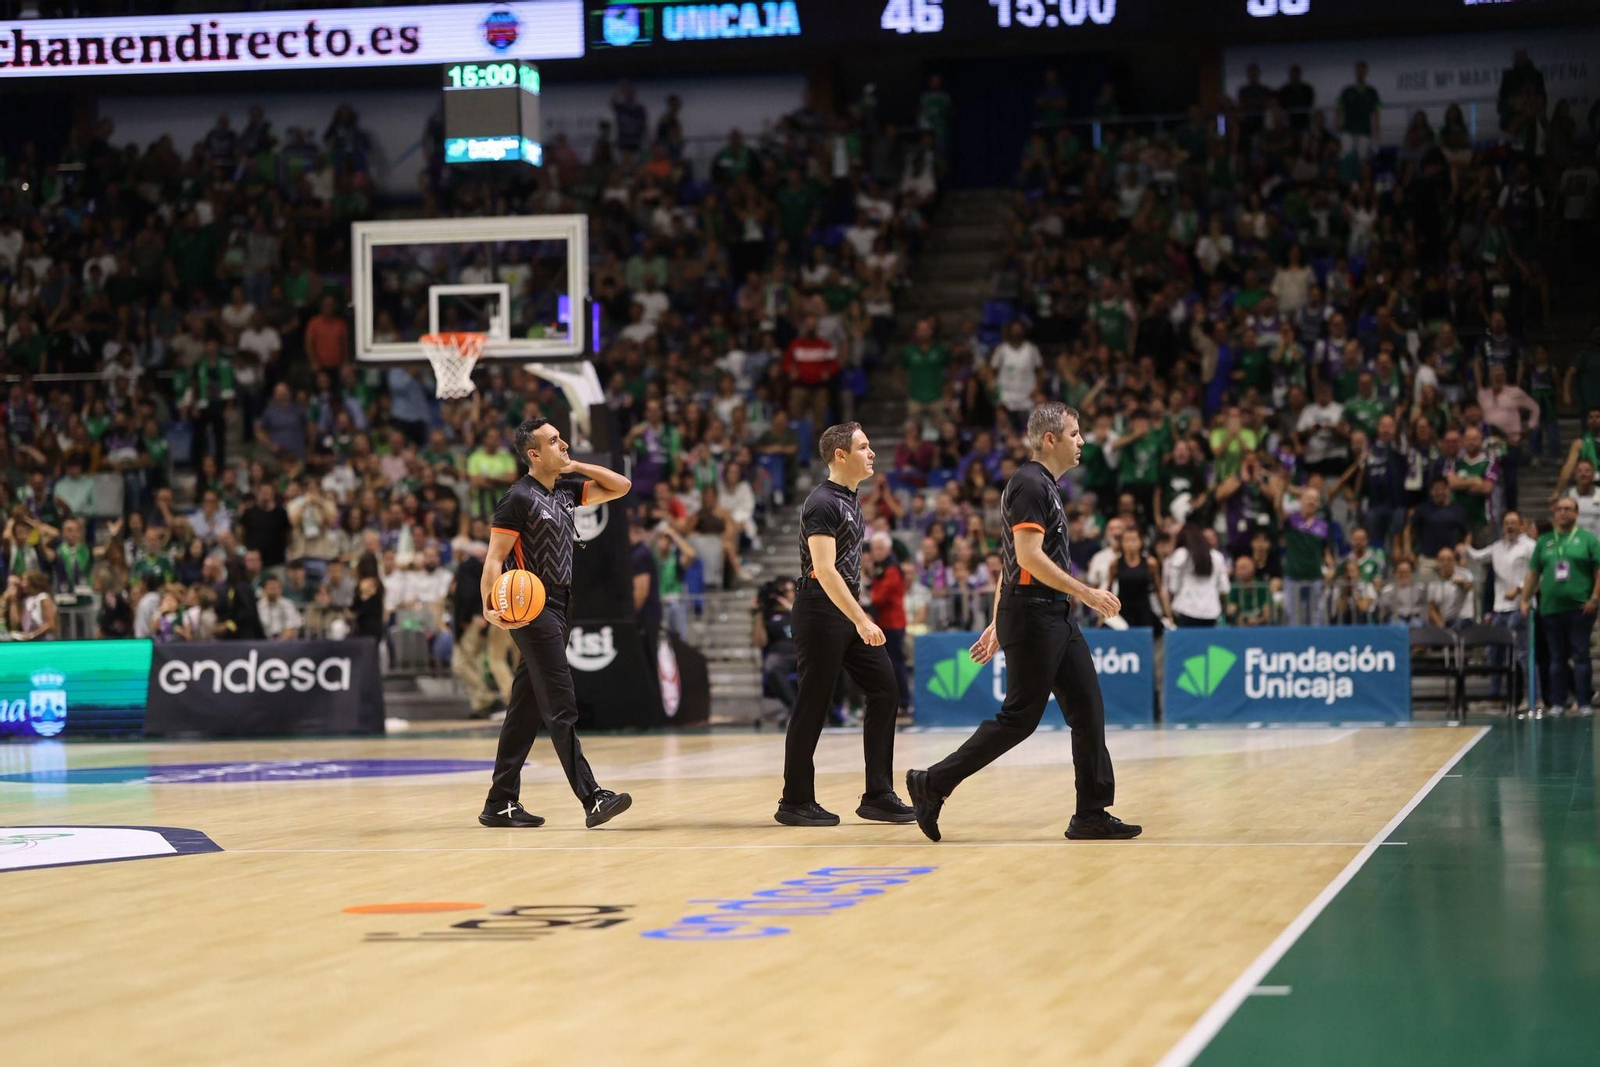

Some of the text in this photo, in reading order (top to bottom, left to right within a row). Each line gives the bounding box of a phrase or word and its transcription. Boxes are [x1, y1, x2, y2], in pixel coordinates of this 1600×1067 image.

[662, 1, 801, 39] UNICAJA
[881, 0, 944, 34] 46
[448, 63, 516, 88] 15:00
[158, 648, 352, 695] endesa
[1244, 645, 1396, 674] Fundación
[1244, 673, 1354, 705] Unicaja
